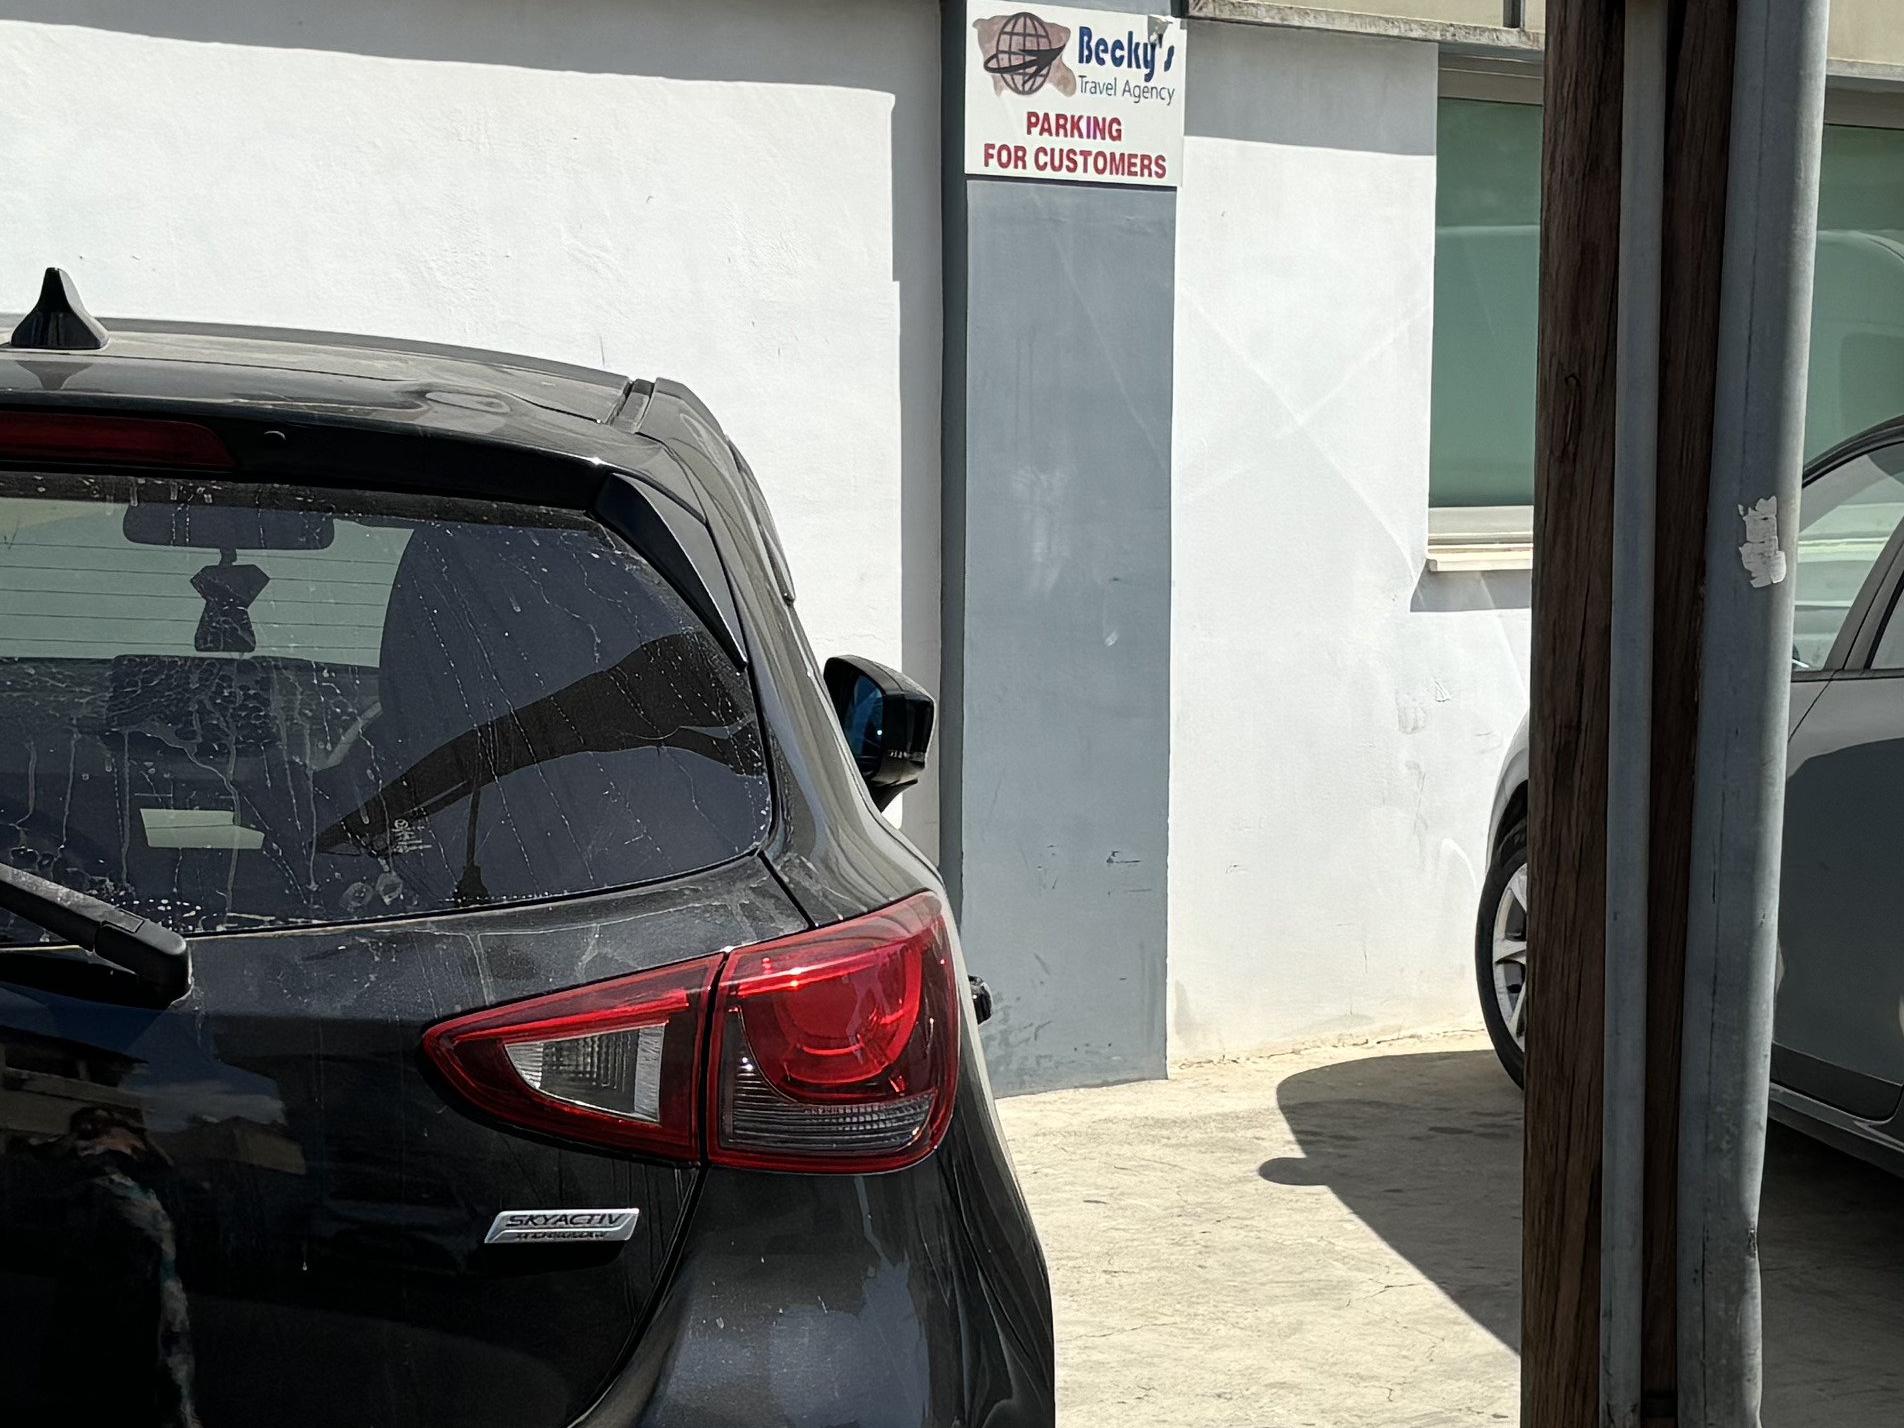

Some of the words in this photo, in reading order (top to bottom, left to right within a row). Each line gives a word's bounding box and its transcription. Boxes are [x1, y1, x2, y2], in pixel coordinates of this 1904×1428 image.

[1078, 26, 1175, 83] Becky's
[1078, 75, 1117, 97] Travel
[1122, 79, 1176, 106] Agency
[1026, 111, 1123, 142] PARKING
[984, 143, 1027, 170] FOR
[1034, 146, 1167, 179] CUSTOMERS
[505, 1213, 627, 1227] SKYACTIV
